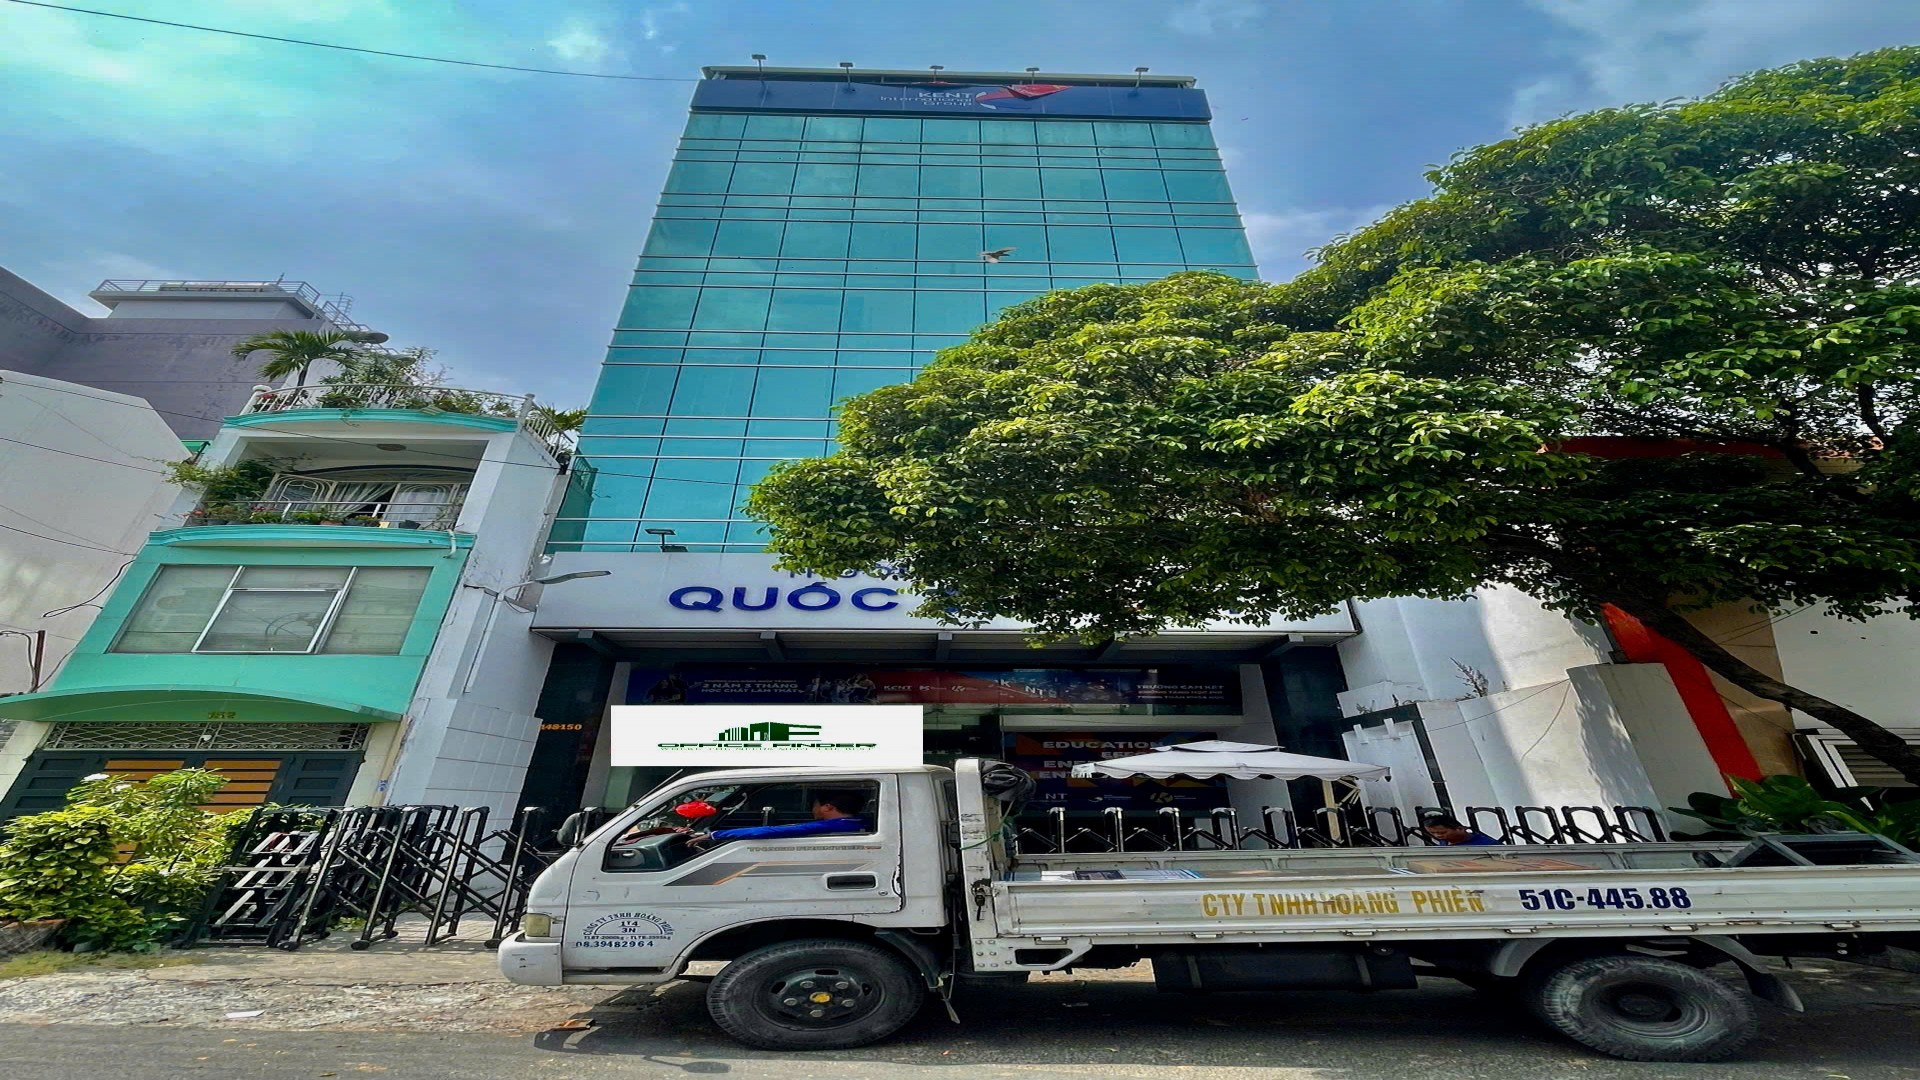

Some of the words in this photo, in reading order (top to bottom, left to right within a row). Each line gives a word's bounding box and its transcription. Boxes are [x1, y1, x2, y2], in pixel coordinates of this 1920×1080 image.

[668, 581, 899, 612] QUỐC
[1202, 893, 1245, 916] CTY
[1518, 887, 1692, 911] 51C-445.88
